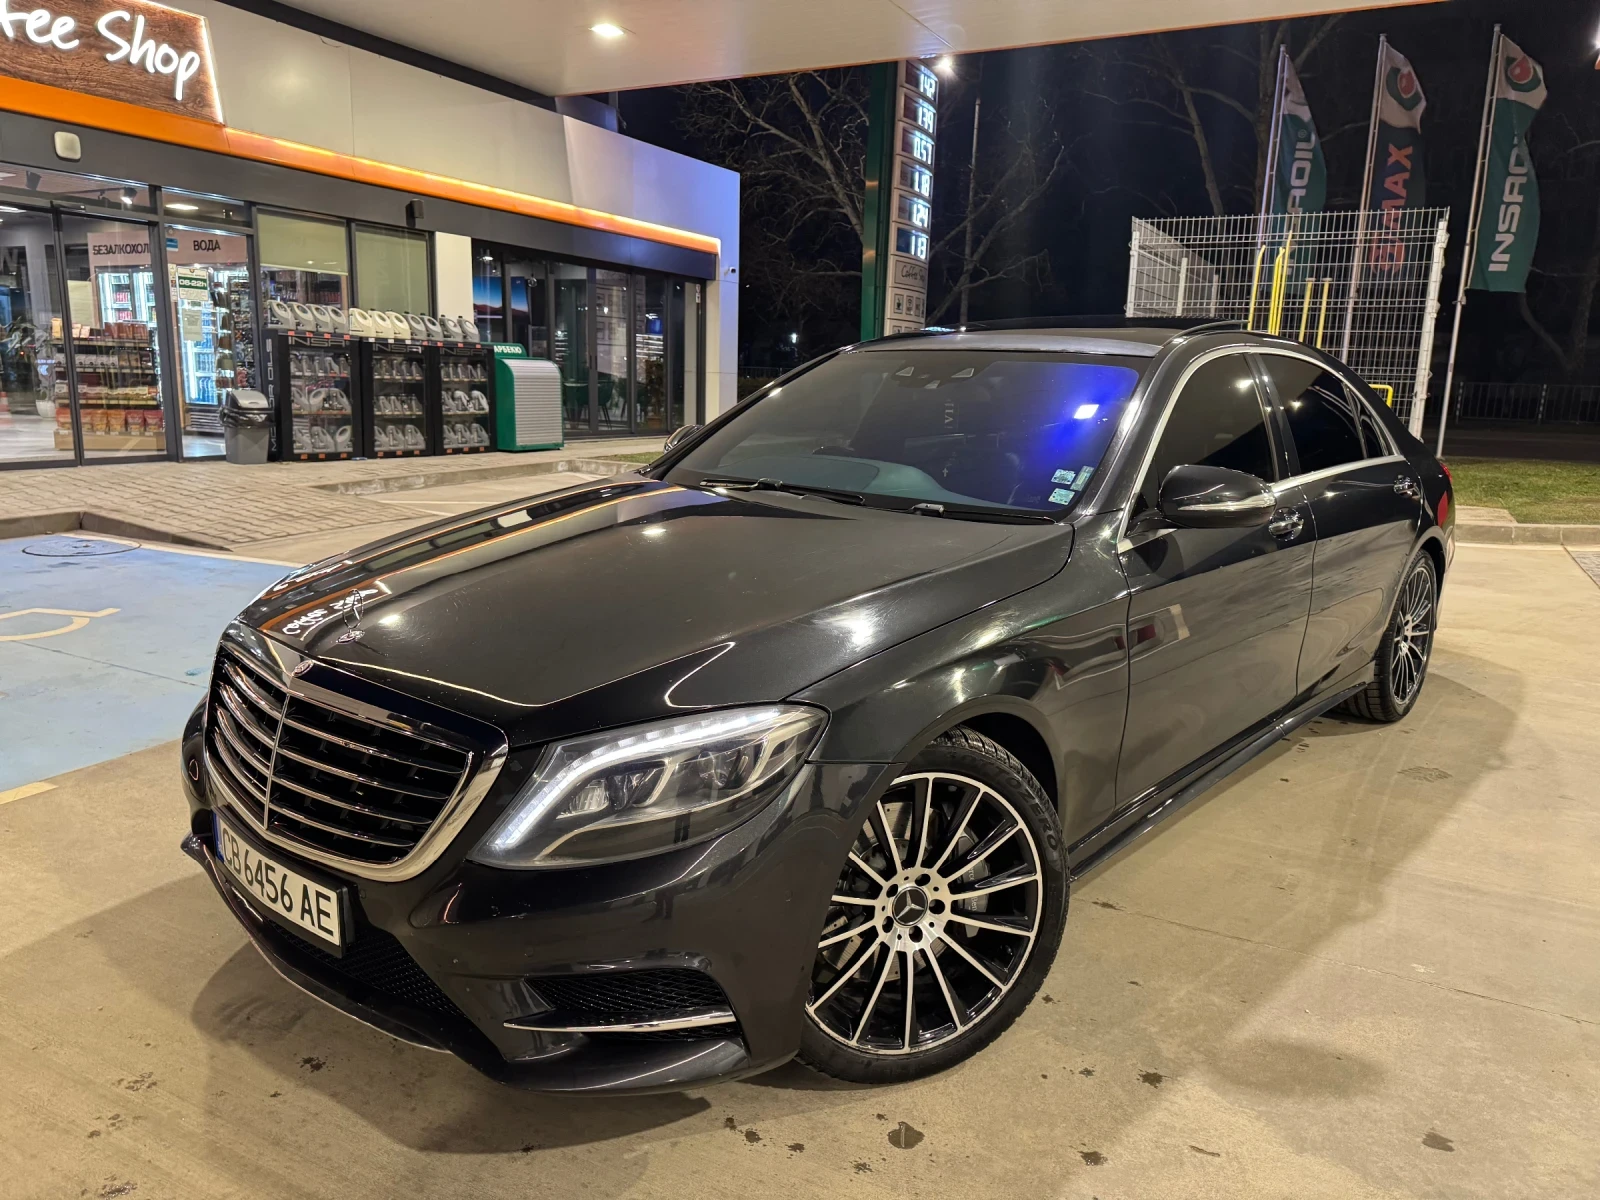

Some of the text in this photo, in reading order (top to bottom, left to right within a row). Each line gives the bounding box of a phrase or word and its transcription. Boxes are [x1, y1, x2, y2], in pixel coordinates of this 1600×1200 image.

[97, 10, 200, 101] Shop
[193, 239, 221, 251] ВОДА
[288, 336, 346, 347] INSA
[372, 343, 422, 354] INSA
[440, 347, 485, 356] INSA
[266, 339, 277, 452] MOOR OILS
[222, 827, 334, 937] CB 6456 AE
